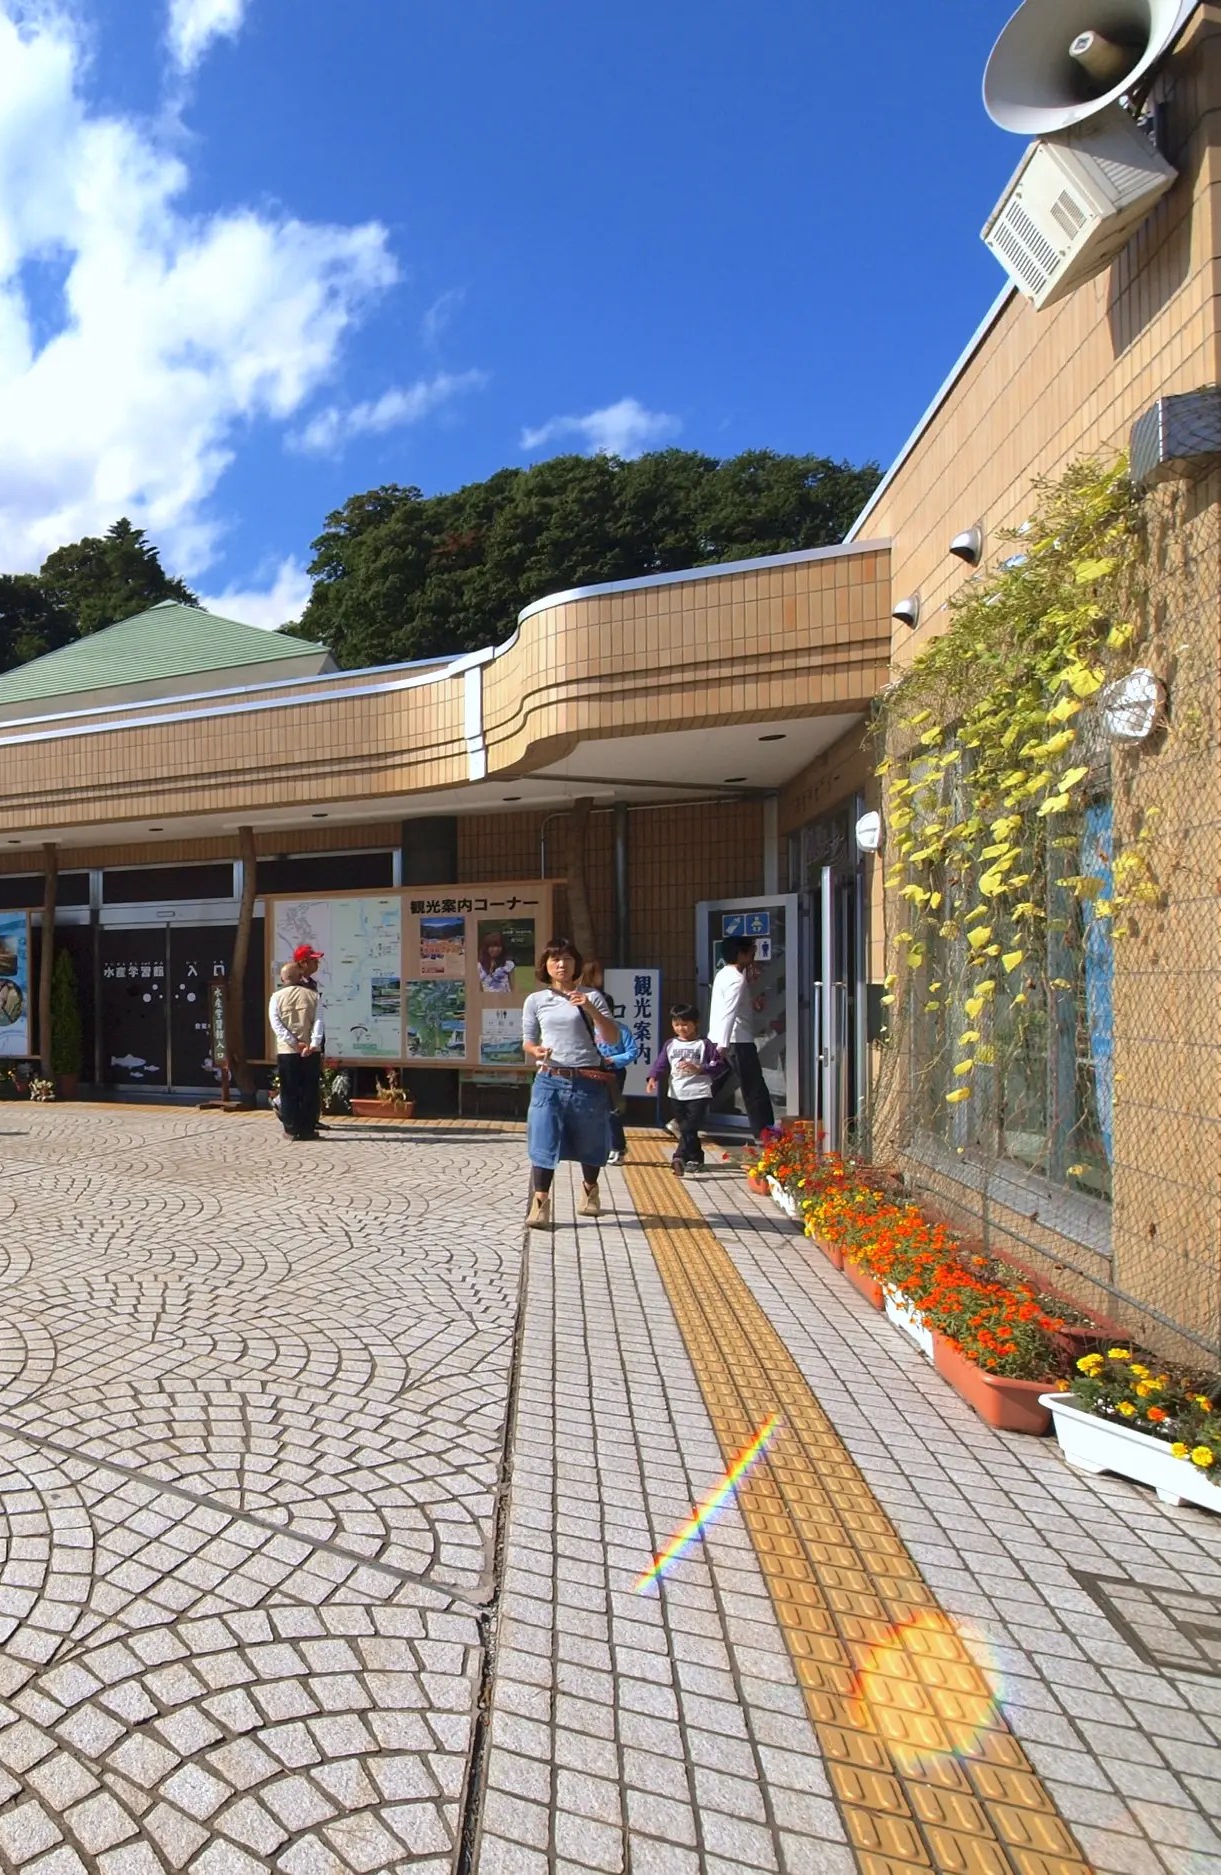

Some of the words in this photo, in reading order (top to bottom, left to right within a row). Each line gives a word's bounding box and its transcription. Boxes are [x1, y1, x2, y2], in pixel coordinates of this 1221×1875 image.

[410, 896, 539, 915] 観光案内コーナー
[104, 966, 164, 978] 水産学習館
[633, 975, 652, 1065] 観光案内
